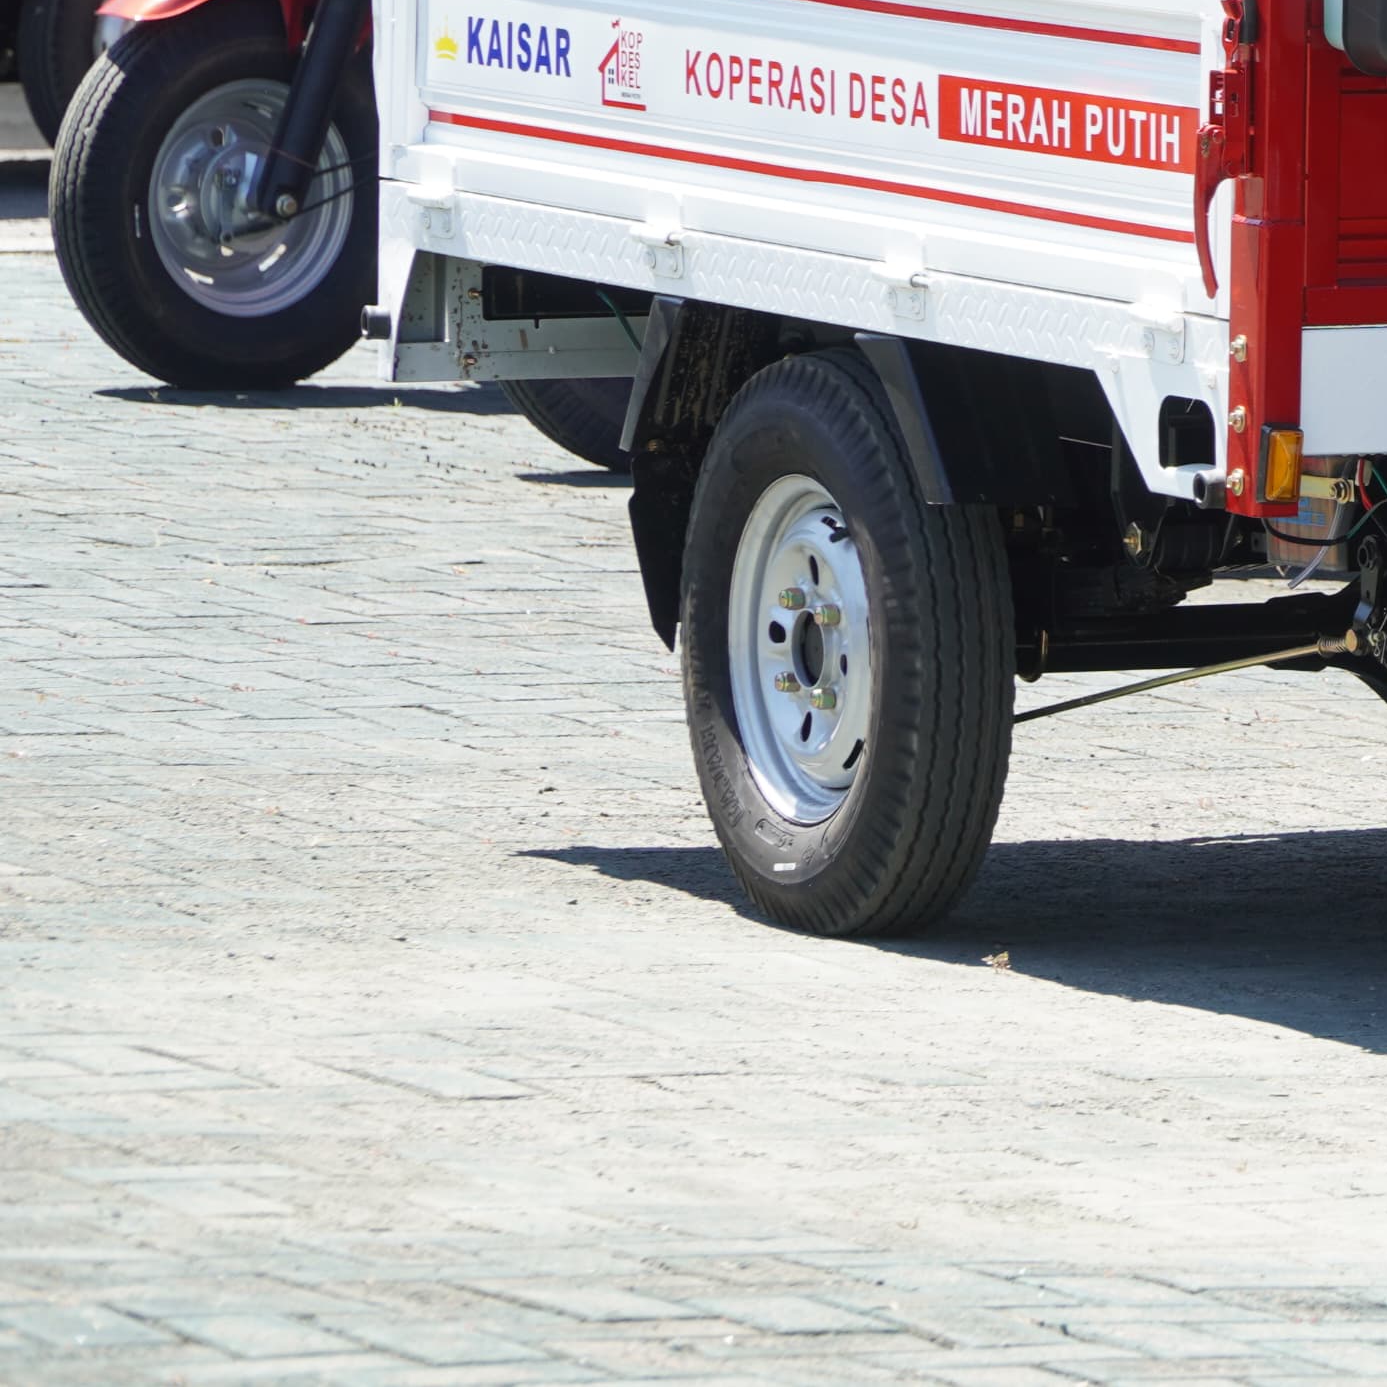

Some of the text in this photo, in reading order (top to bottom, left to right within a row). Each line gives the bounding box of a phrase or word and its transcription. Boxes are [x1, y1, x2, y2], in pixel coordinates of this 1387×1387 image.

[467, 16, 571, 77] KAISAR
[620, 31, 643, 49] KOP
[620, 50, 641, 69] DES
[620, 70, 641, 89] KEL
[685, 49, 930, 129] KOPERASI DESA
[959, 87, 1181, 165] MERAH PUTIH
